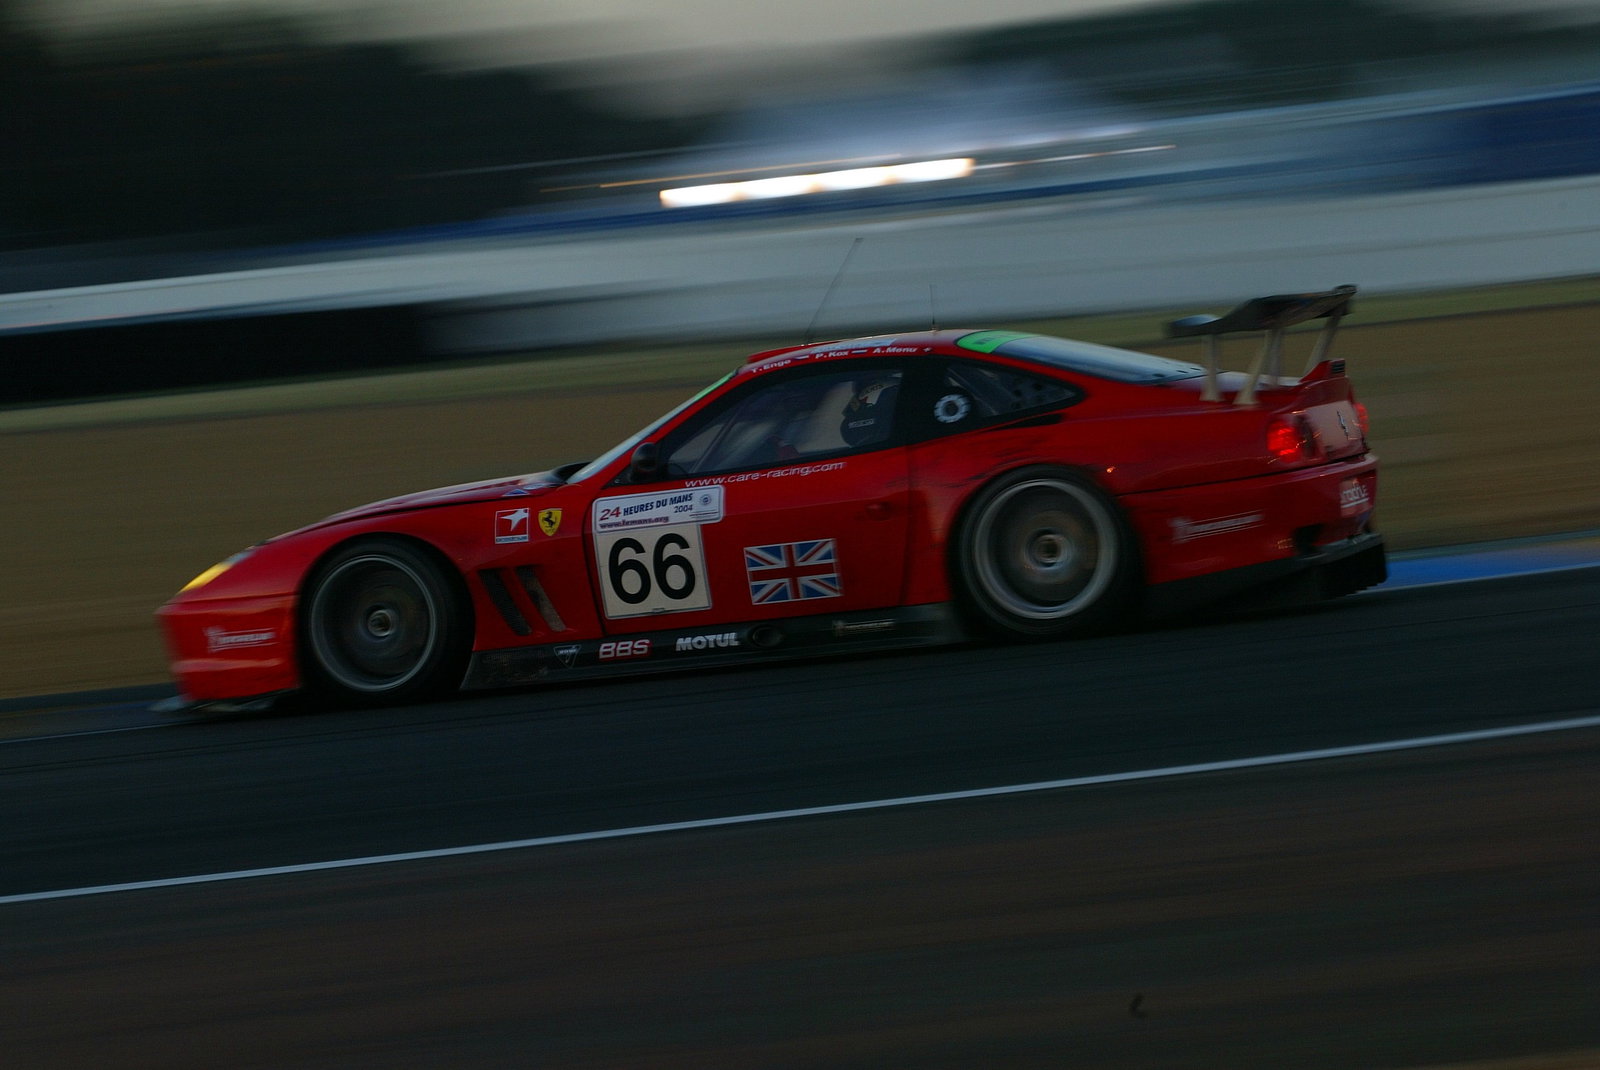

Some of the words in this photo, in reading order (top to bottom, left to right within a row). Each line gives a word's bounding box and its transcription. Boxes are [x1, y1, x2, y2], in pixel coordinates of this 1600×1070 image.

[685, 461, 847, 487] www.care-racing.com
[600, 506, 620, 520] 24
[623, 501, 654, 516] HEURES
[656, 499, 668, 508] DU
[669, 493, 693, 505] MANS
[674, 504, 693, 513] 2004
[608, 533, 696, 604] 66
[599, 639, 651, 659] BBS
[675, 632, 741, 651] MOTUL
